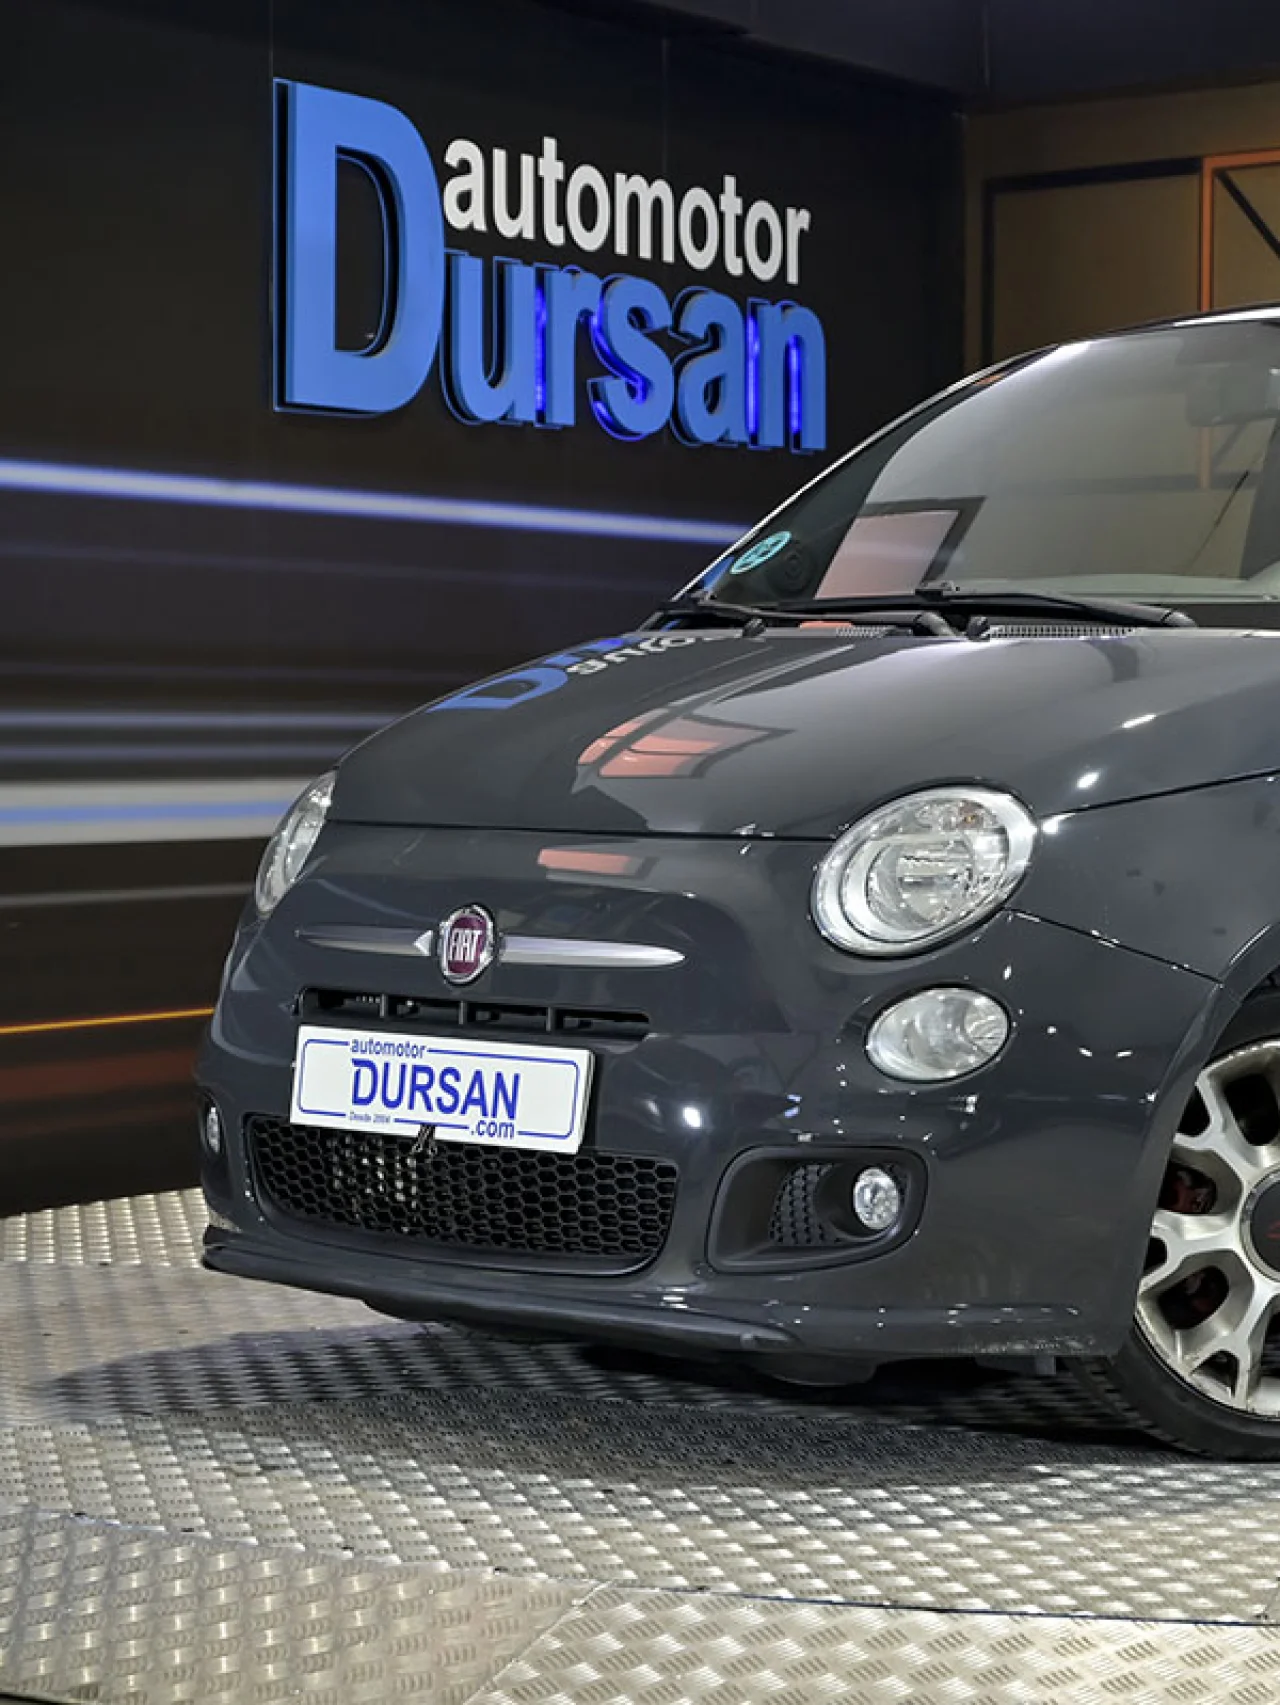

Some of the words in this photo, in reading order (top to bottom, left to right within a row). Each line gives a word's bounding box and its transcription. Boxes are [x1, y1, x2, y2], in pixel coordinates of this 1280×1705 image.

[443, 136, 812, 285] automotor
[273, 78, 828, 453] Dursan
[449, 927, 483, 963] FIAT
[350, 1037, 427, 1059] automotor
[351, 1057, 521, 1120] DURSAN
[470, 1119, 516, 1139] .com
